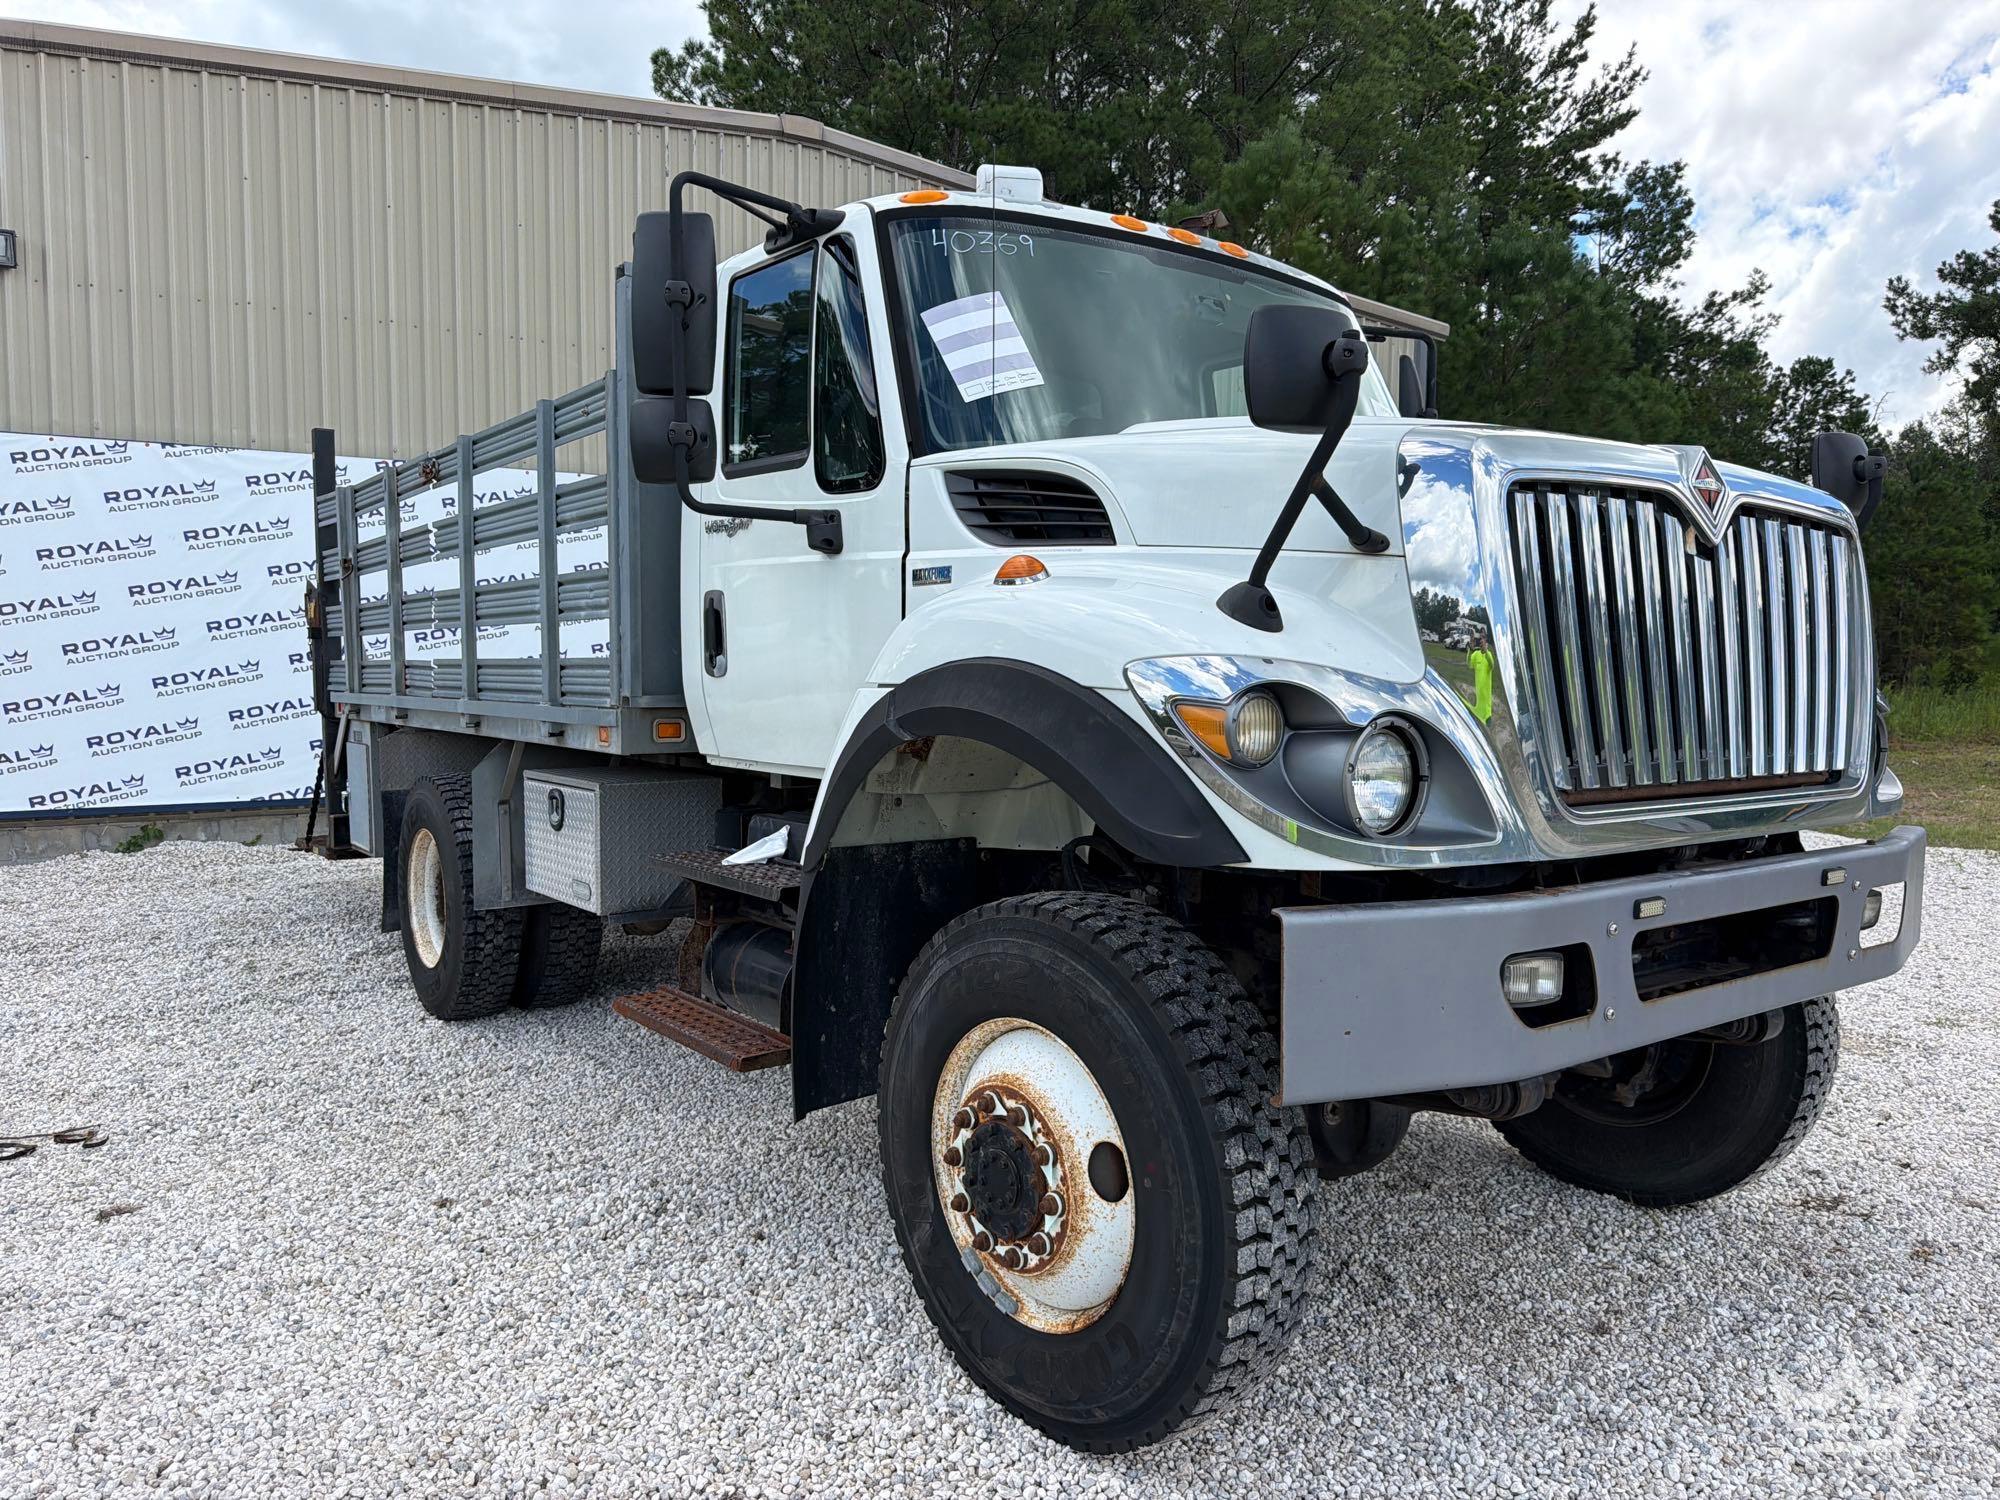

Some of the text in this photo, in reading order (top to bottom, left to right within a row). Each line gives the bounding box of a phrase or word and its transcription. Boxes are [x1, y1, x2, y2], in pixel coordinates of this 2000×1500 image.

[932, 228, 1034, 257] 40369
[9, 444, 106, 464] ROYAL
[15, 455, 133, 474] AUCTION GROUP
[245, 469, 314, 488] ROYA
[103, 483, 194, 504] ROYAL
[249, 483, 306, 497] AUCTION
[108, 494, 220, 514] AUCTION GROUP
[24, 511, 76, 523] GROUP
[183, 521, 269, 542] ROYAL
[187, 531, 294, 551] AUCTION GROUP
[566, 533, 603, 544] GROUP
[36, 539, 130, 561] ROYAL
[41, 549, 157, 571] AUCTION GROUP
[267, 559, 318, 577] ROY
[128, 575, 217, 598] ROYAL
[271, 573, 317, 586] AUCTIO
[0, 596, 74, 616] OYAL
[132, 584, 242, 607] AUCTION GROUP
[0, 605, 101, 626] CTION GROUP
[206, 610, 290, 633] ROYAL
[210, 620, 307, 642] AUCTION GROU
[417, 630, 509, 651] AUCTIO ROUP
[61, 632, 154, 656] ROYAL
[66, 641, 180, 666] AUCTION GROUP
[152, 665, 240, 689] ROYAL
[156, 673, 264, 698] AUCTION GROUP
[2, 689, 98, 715] ROYAL
[7, 698, 125, 724] AUCTION GROUP
[228, 697, 312, 722] ROYAL
[232, 708, 318, 731] AUCTION GRO
[86, 722, 177, 749] ROYAL
[91, 731, 203, 758] AUCTION GROUP
[7, 758, 59, 774] GROUP
[175, 753, 261, 779] ROYAL
[179, 760, 285, 788] AUCTION GROUP
[28, 781, 122, 808] ROYAL
[99, 788, 149, 804] GROUP
